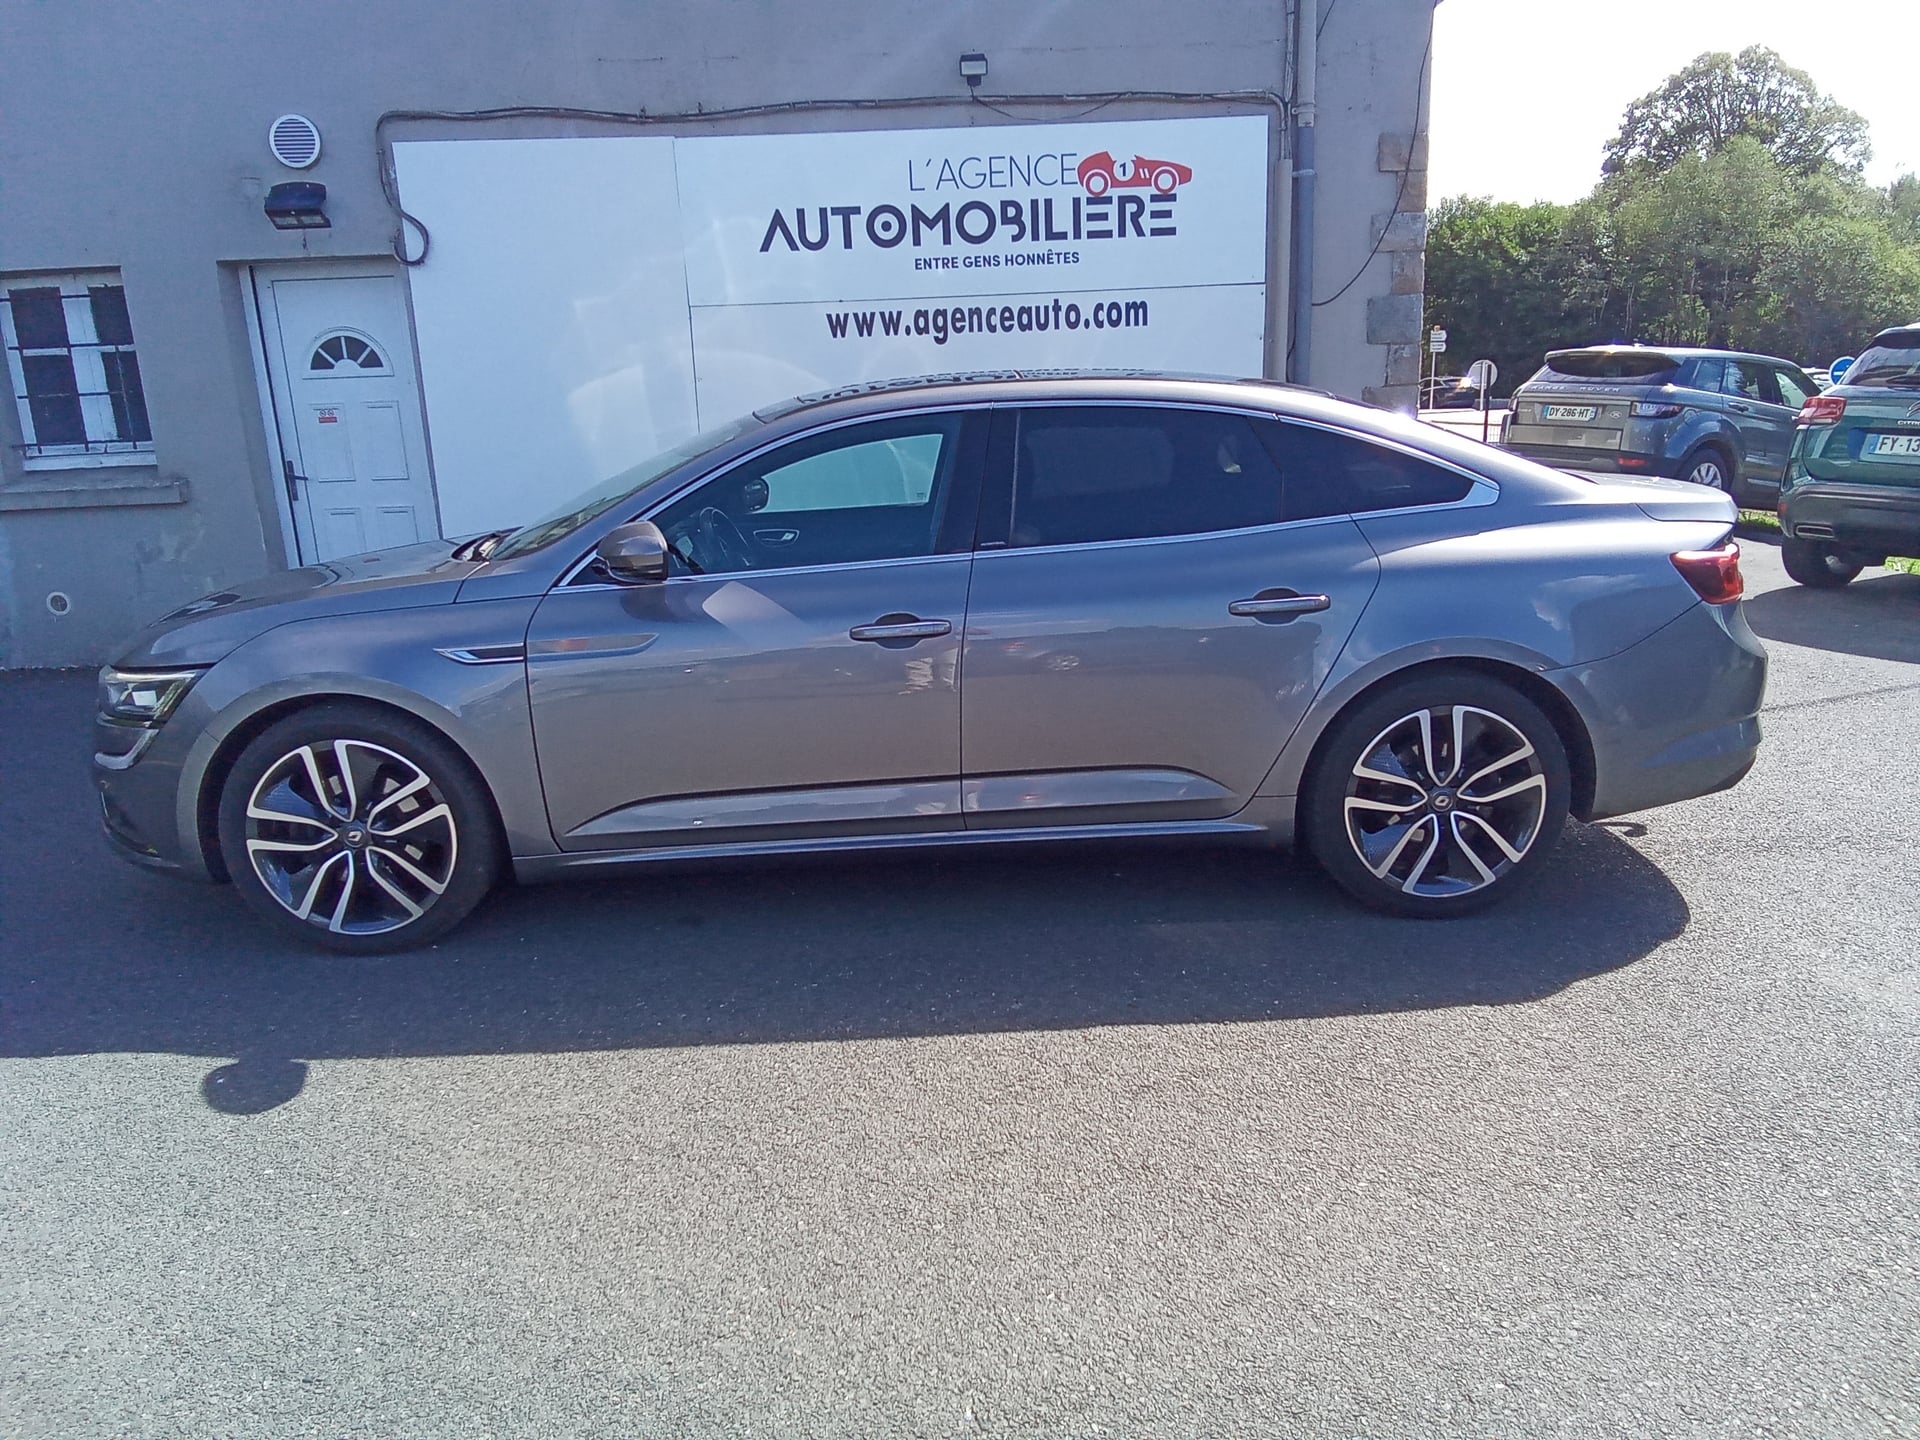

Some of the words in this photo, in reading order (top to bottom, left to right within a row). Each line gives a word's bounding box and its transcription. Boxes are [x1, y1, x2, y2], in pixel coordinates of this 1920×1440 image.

[908, 153, 1079, 191] L'AGENCE
[1118, 161, 1128, 177] 1
[914, 257, 958, 271] ENTRE
[963, 255, 1000, 268] GENS
[1005, 249, 1080, 266] HONNÊTES
[826, 299, 1149, 345] www.agenceauto.com
